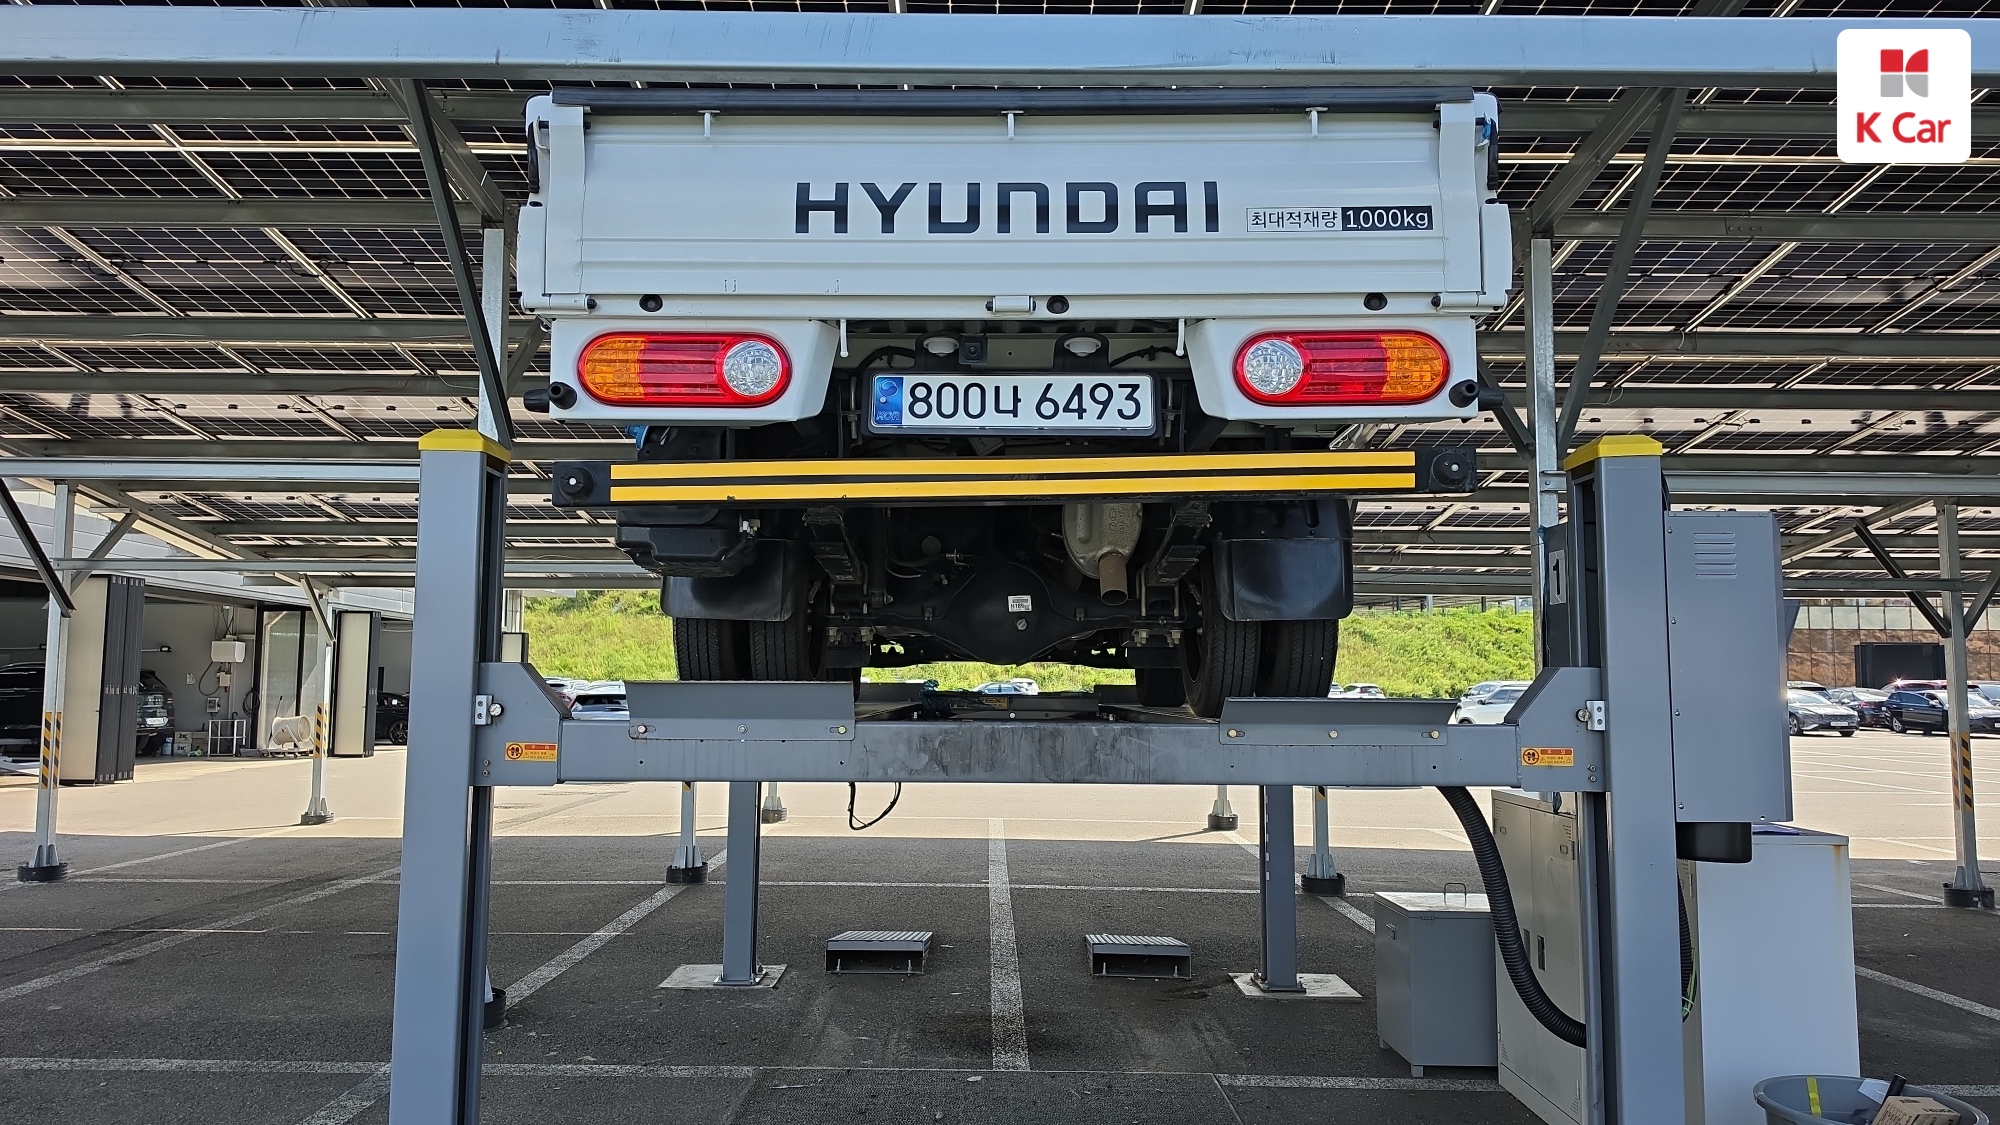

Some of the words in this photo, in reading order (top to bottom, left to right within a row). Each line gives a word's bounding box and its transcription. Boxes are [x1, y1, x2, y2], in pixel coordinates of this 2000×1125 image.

[795, 181, 1220, 234] HYUNDAI
[1251, 210, 1338, 229] 최대적재량
[1346, 209, 1429, 230] 1,000kg
[908, 382, 1022, 420] 800나
[1035, 382, 1141, 420] 6493
[1552, 559, 1561, 595] 1
